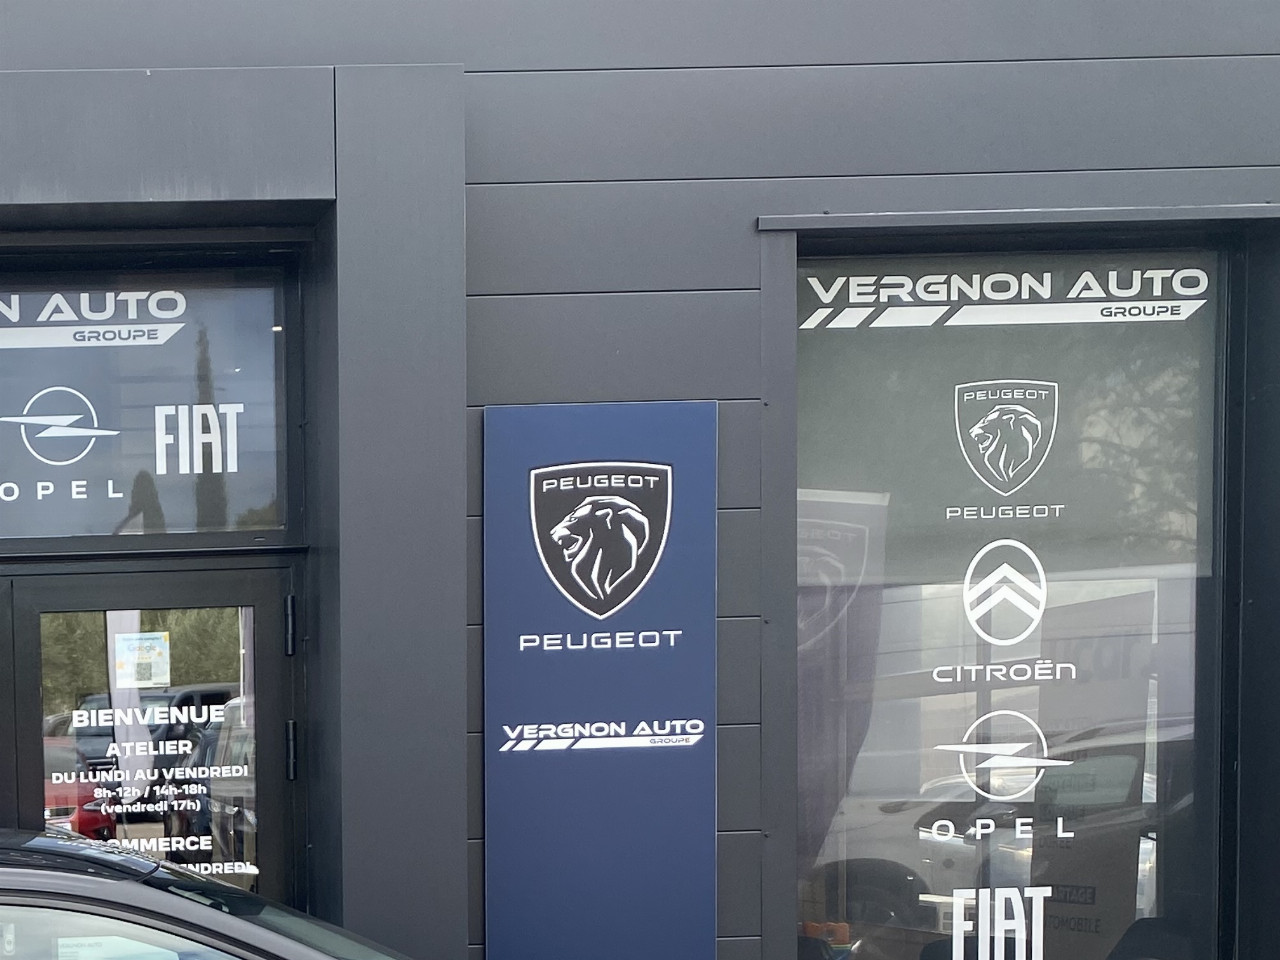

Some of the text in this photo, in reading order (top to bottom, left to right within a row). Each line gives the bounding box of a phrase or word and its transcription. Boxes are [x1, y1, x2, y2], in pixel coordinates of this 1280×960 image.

[807, 268, 1210, 304] VERGNON AUTO
[36, 290, 188, 321] AUTO
[1100, 304, 1182, 318] GROUPE
[72, 328, 159, 342] GROUPE
[963, 389, 1049, 402] PEUGEOT
[154, 403, 245, 475] FIAT
[542, 474, 660, 493] PEUGEOT
[946, 504, 1066, 520] PEUGEOT
[519, 630, 683, 651] PEUGEOT
[71, 704, 226, 728] BIENVENUE
[502, 719, 705, 738] VERGNON AUTO
[105, 740, 193, 758] ATELIER
[649, 736, 691, 744] GROUPE
[51, 764, 249, 784] DU LUNDI AU VENDREDI
[93, 784, 208, 799] 8h-12h / 14h-18h
[100, 798, 202, 815] (vendredi 17h)
[931, 816, 1076, 842] OPEL
